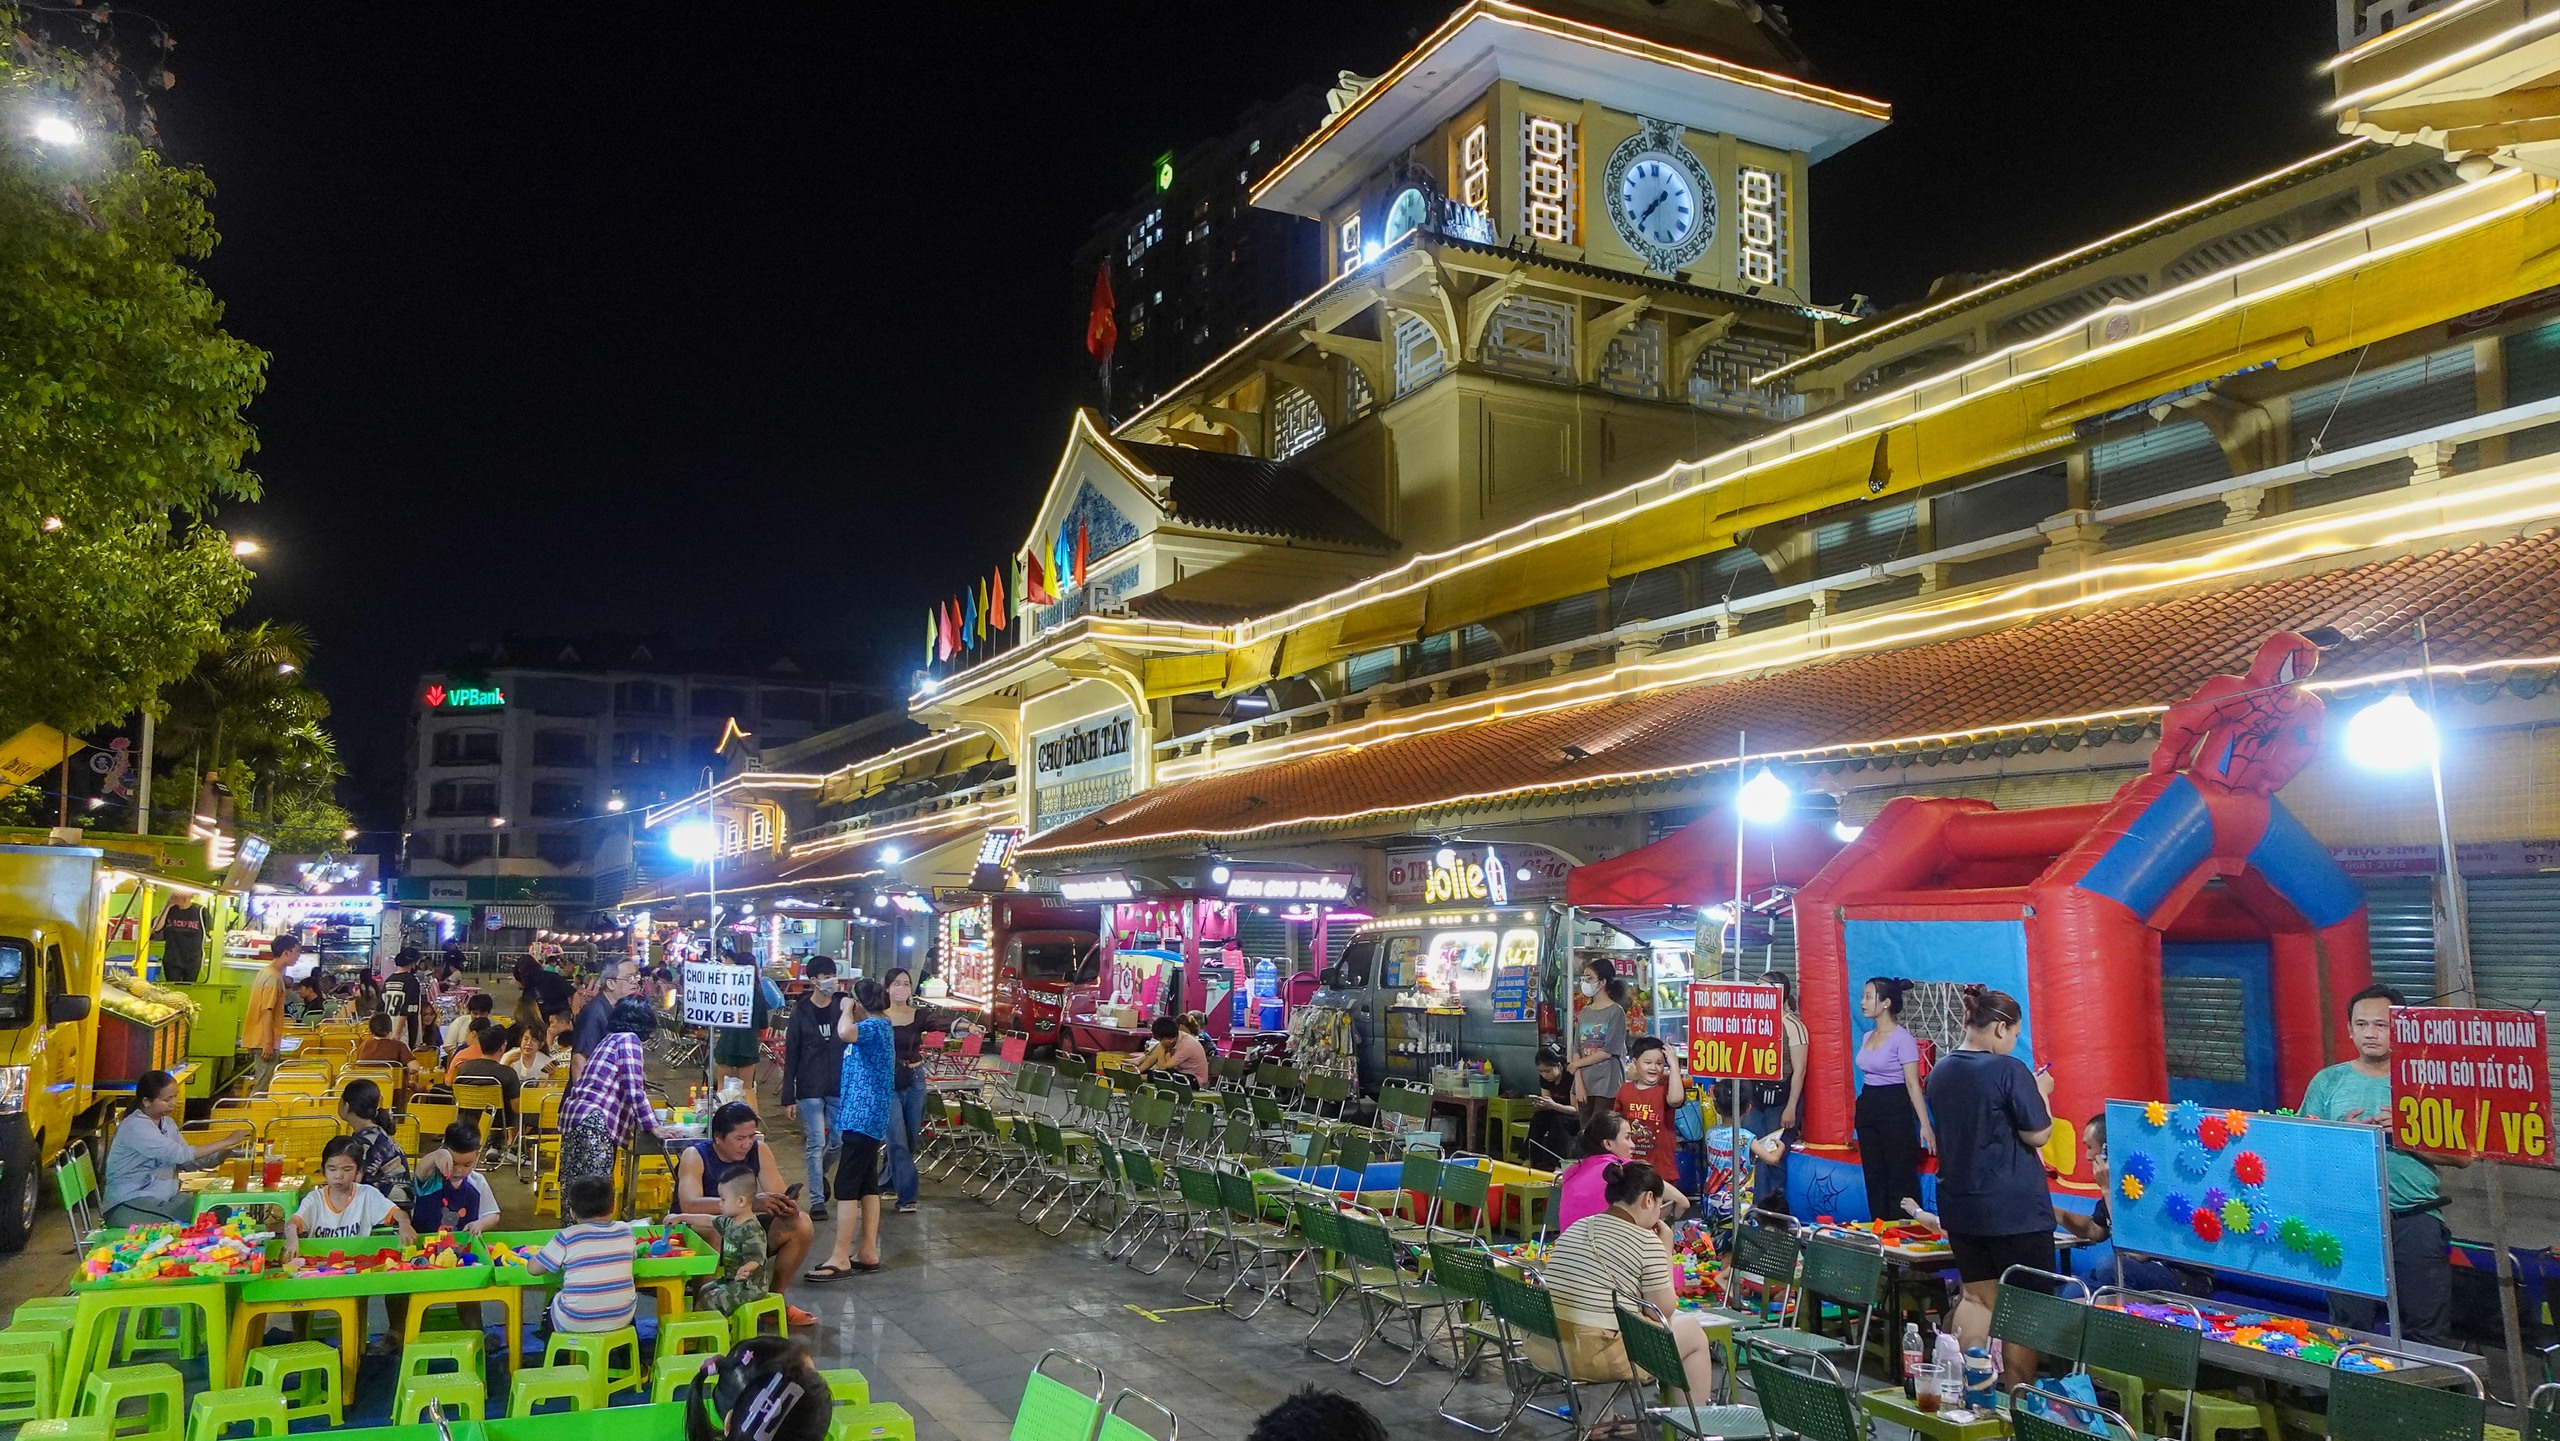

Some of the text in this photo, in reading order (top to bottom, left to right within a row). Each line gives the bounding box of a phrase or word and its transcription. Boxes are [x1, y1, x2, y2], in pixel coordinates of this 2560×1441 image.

[450, 687, 505, 706] VPBank
[1038, 715, 1132, 777] CHỢ BÌNH TÂY
[708, 968, 728, 985] HẾT
[732, 970, 752, 986] TẤT
[699, 988, 717, 1005] TRÒ
[1694, 987, 1776, 1010] TRÒ CHƠI LIÊN HOÀN
[1726, 1014, 1740, 1034] GÓI
[1742, 1013, 1757, 1035] TẤT
[1758, 1014, 1773, 1037] CẢ)
[2394, 1015, 2537, 1048] TRÒ CHƠI LIÊN HOÀN
[1693, 1039, 1732, 1073] 30k
[1752, 1042, 1777, 1075] vé
[2450, 1056, 2475, 1087] GÓI
[2478, 1054, 2504, 1089] TẤT
[2507, 1055, 2534, 1092] CẢ)
[1629, 1103, 1654, 1113] EVEL
[2399, 1095, 2467, 1151] 30k
[2500, 1101, 2546, 1157] vé
[315, 1221, 362, 1238] CHRISTIAN
